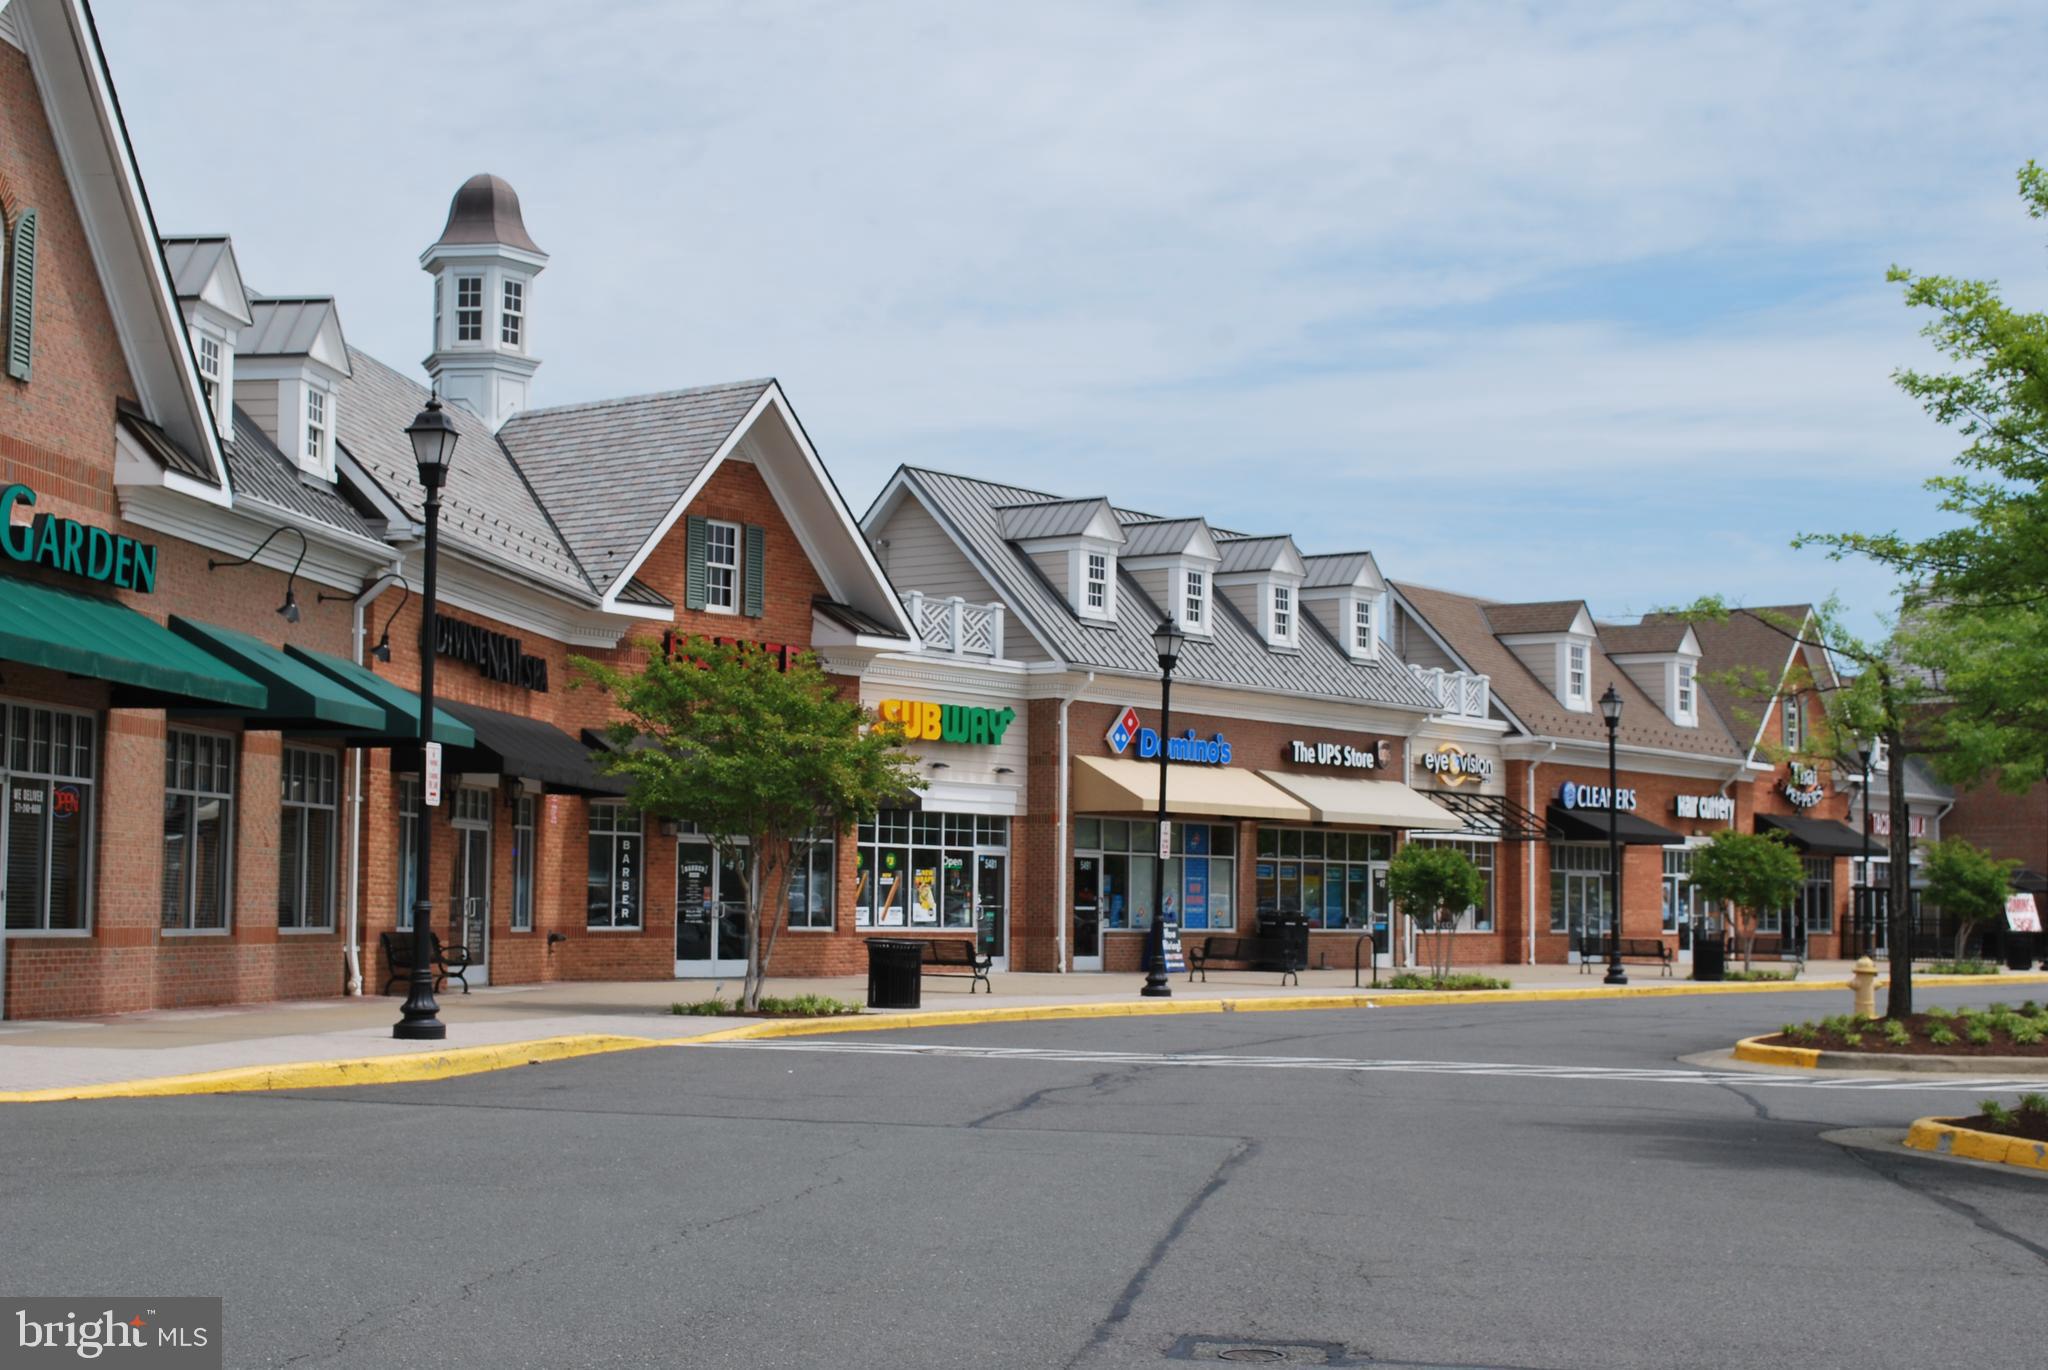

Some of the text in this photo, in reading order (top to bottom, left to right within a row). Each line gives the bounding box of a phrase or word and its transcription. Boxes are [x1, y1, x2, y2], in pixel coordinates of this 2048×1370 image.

[0, 483, 157, 594] GARDEN
[871, 699, 1016, 745] SUBWAY
[1292, 740, 1374, 769] The UPS Store
[1424, 752, 1494, 774] eye vision
[621, 840, 630, 918] BARBER
